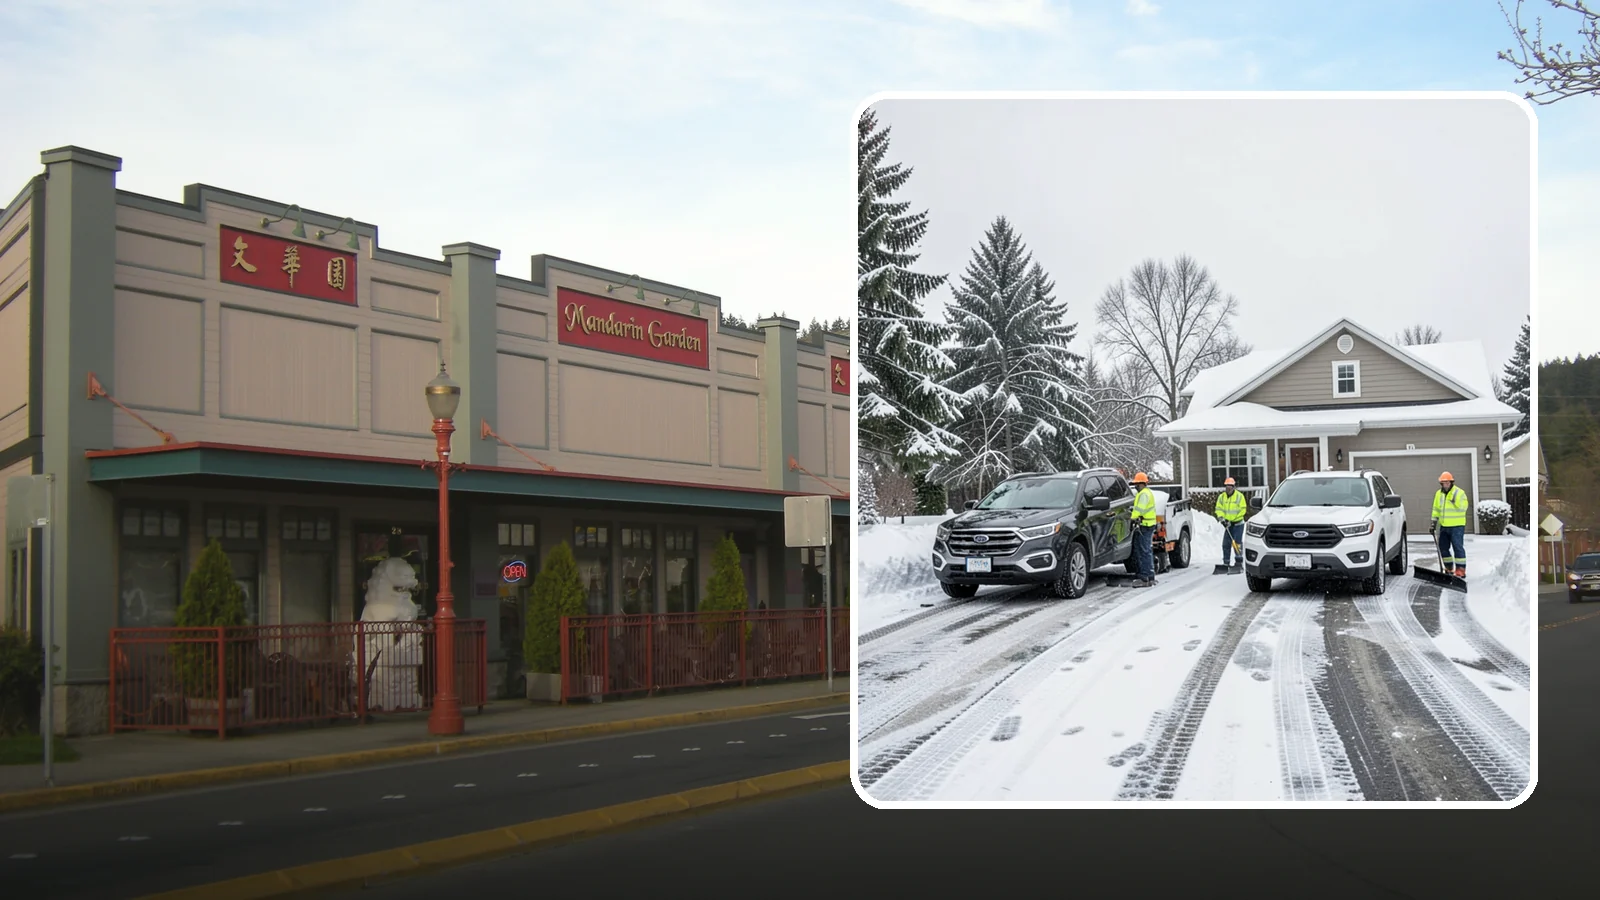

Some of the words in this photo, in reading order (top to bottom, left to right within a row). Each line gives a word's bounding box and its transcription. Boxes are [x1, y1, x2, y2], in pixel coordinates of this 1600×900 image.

[231, 236, 346, 290] 文華園
[565, 302, 644, 340] Mandarin
[648, 320, 701, 351] Garden
[503, 565, 527, 578] OPEN
